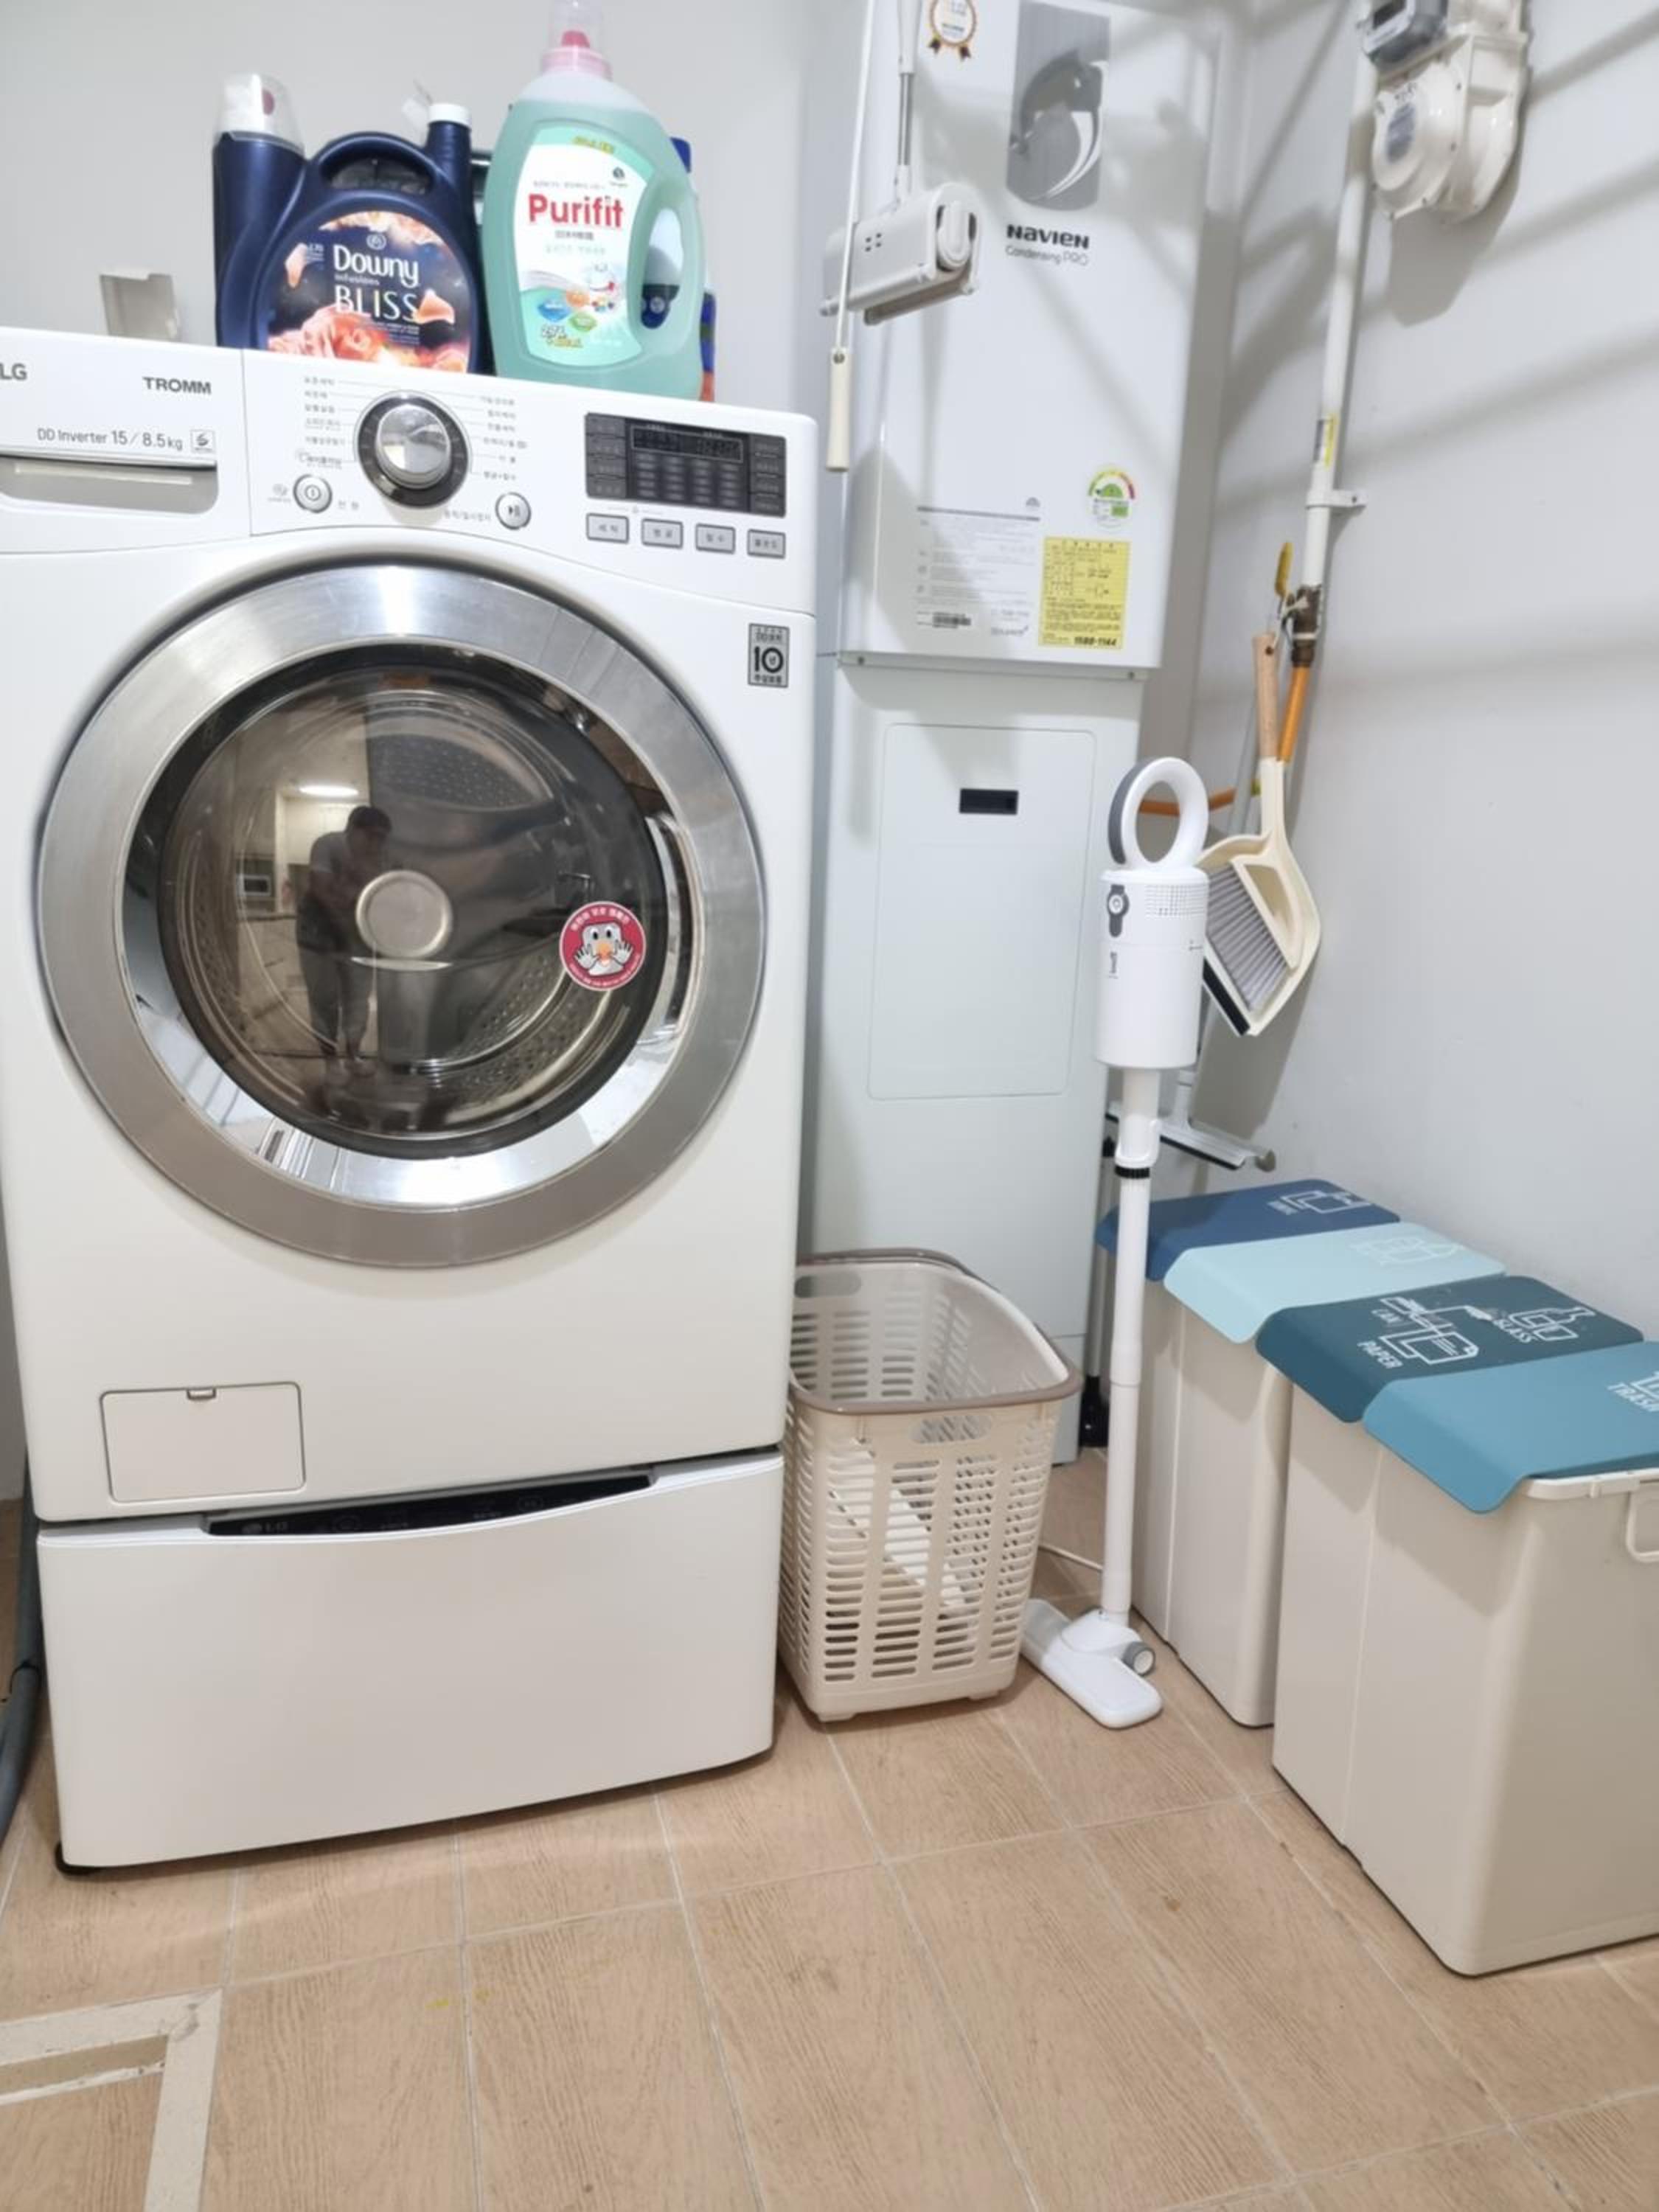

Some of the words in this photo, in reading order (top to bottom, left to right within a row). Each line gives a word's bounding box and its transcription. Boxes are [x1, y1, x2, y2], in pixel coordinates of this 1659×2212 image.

[529, 193, 624, 229] Purifit
[333, 243, 420, 288] Downy
[1062, 250, 1088, 266] PRO
[335, 285, 420, 322] BLISS
[0, 362, 28, 381] LG
[142, 375, 212, 395] TROMM
[37, 427, 56, 442] DD
[58, 428, 108, 445] Inverter
[1357, 1340, 1404, 1370] PAPER
